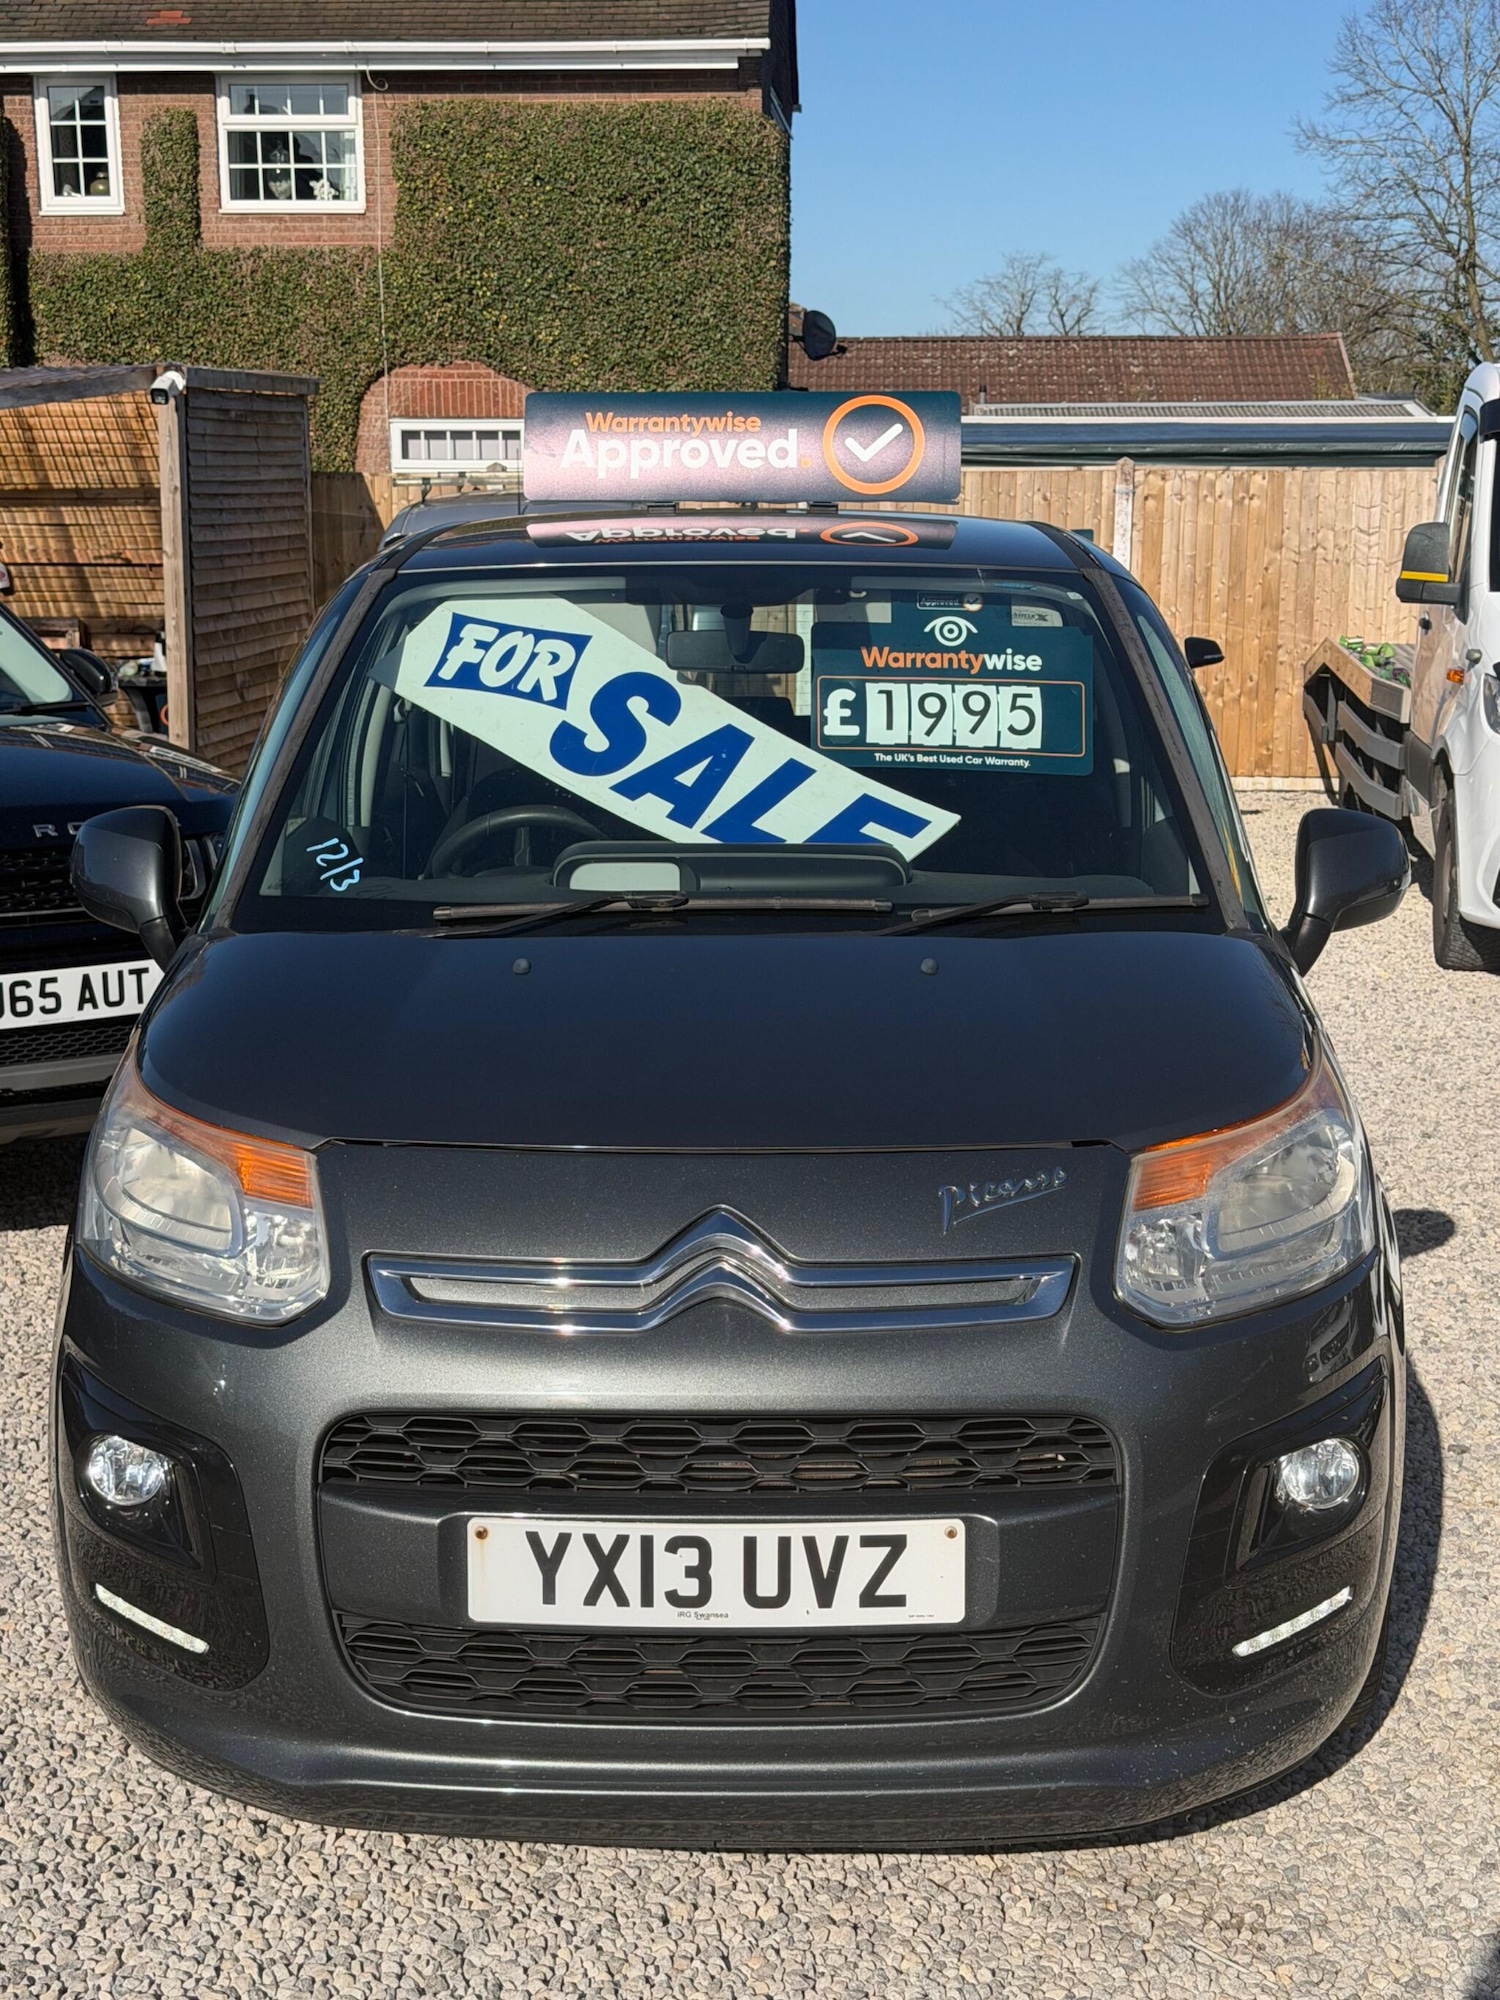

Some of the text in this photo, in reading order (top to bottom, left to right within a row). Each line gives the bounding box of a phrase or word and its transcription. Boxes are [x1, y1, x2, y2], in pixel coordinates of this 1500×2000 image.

[585, 411, 762, 438] Warrantywise
[437, 621, 577, 702] FOR
[860, 646, 1042, 674] Warrantywise
[874, 753, 1031, 768] The UK's Best Used Car Warranty.
[77, 967, 149, 1012] AUT
[525, 1531, 908, 1609] YX13 UVZ
